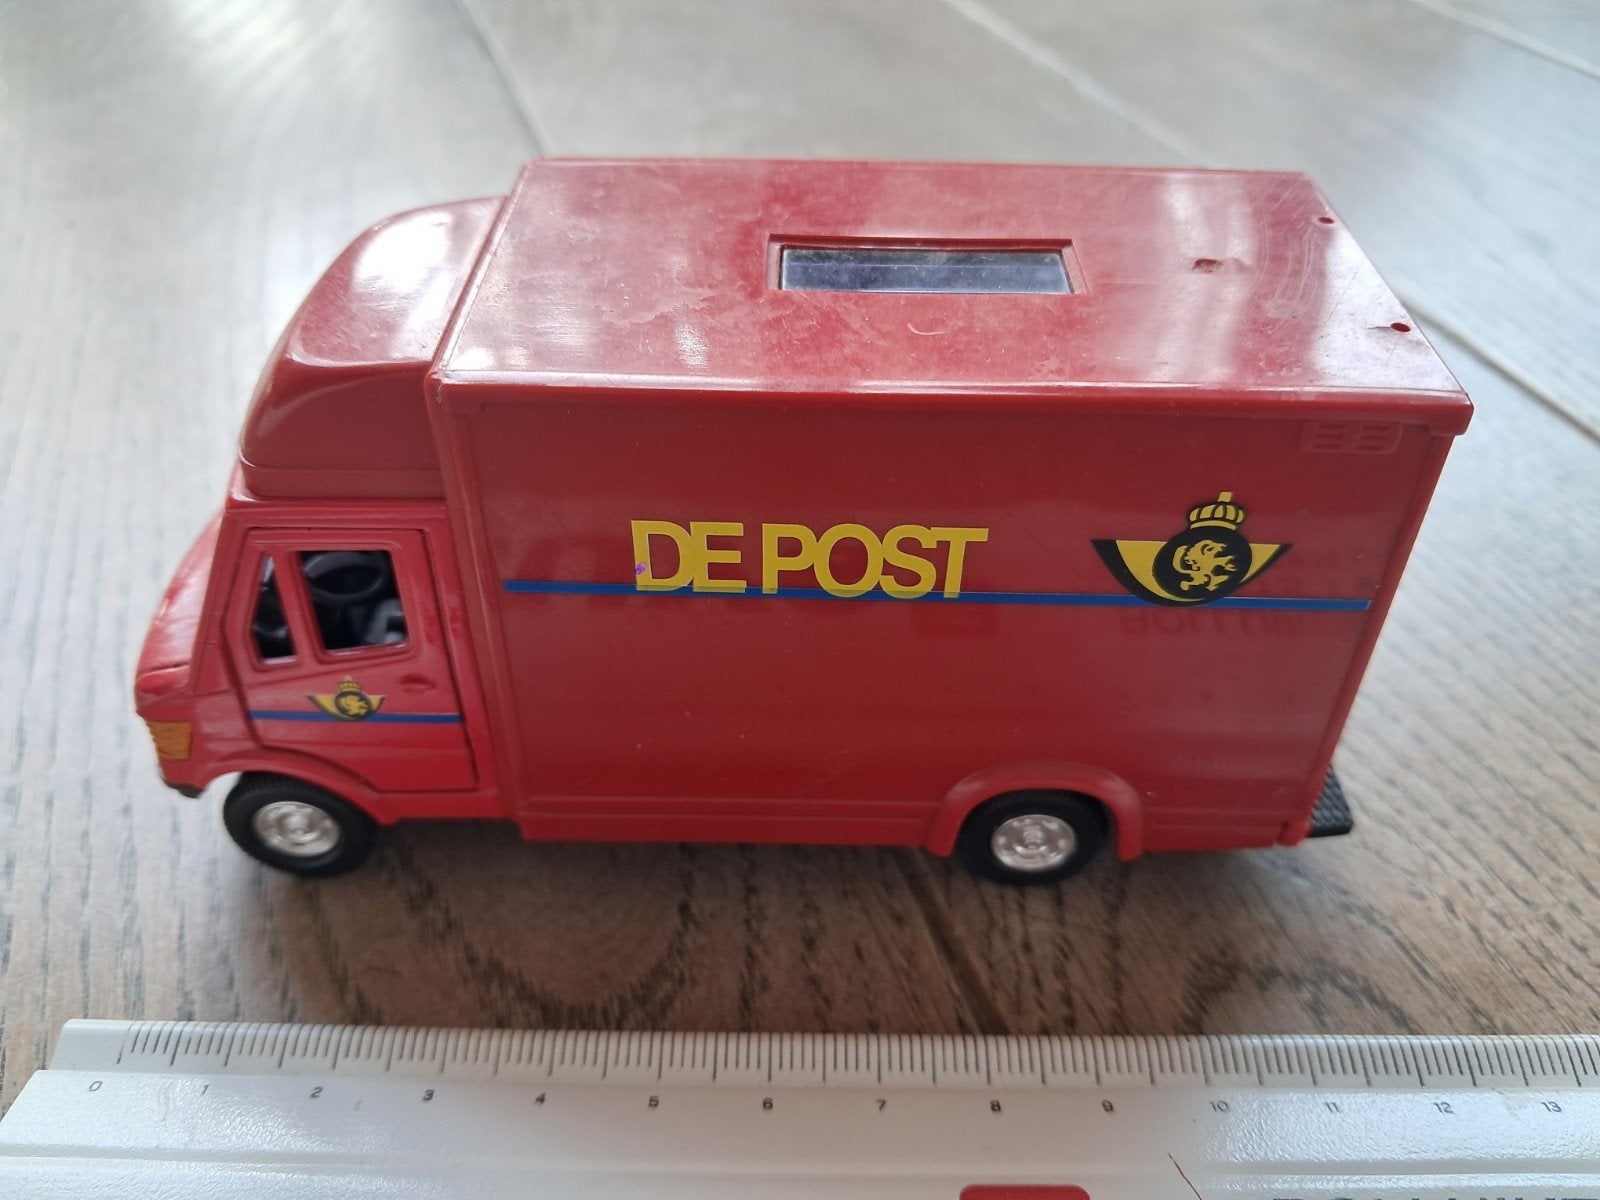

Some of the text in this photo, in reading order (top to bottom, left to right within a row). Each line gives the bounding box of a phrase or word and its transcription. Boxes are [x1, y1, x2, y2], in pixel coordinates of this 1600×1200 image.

[631, 520, 989, 599] DE POST
[88, 1080, 1562, 1114] 0 1 2 3 4 5 6 7 8 9 10 11 12 13
